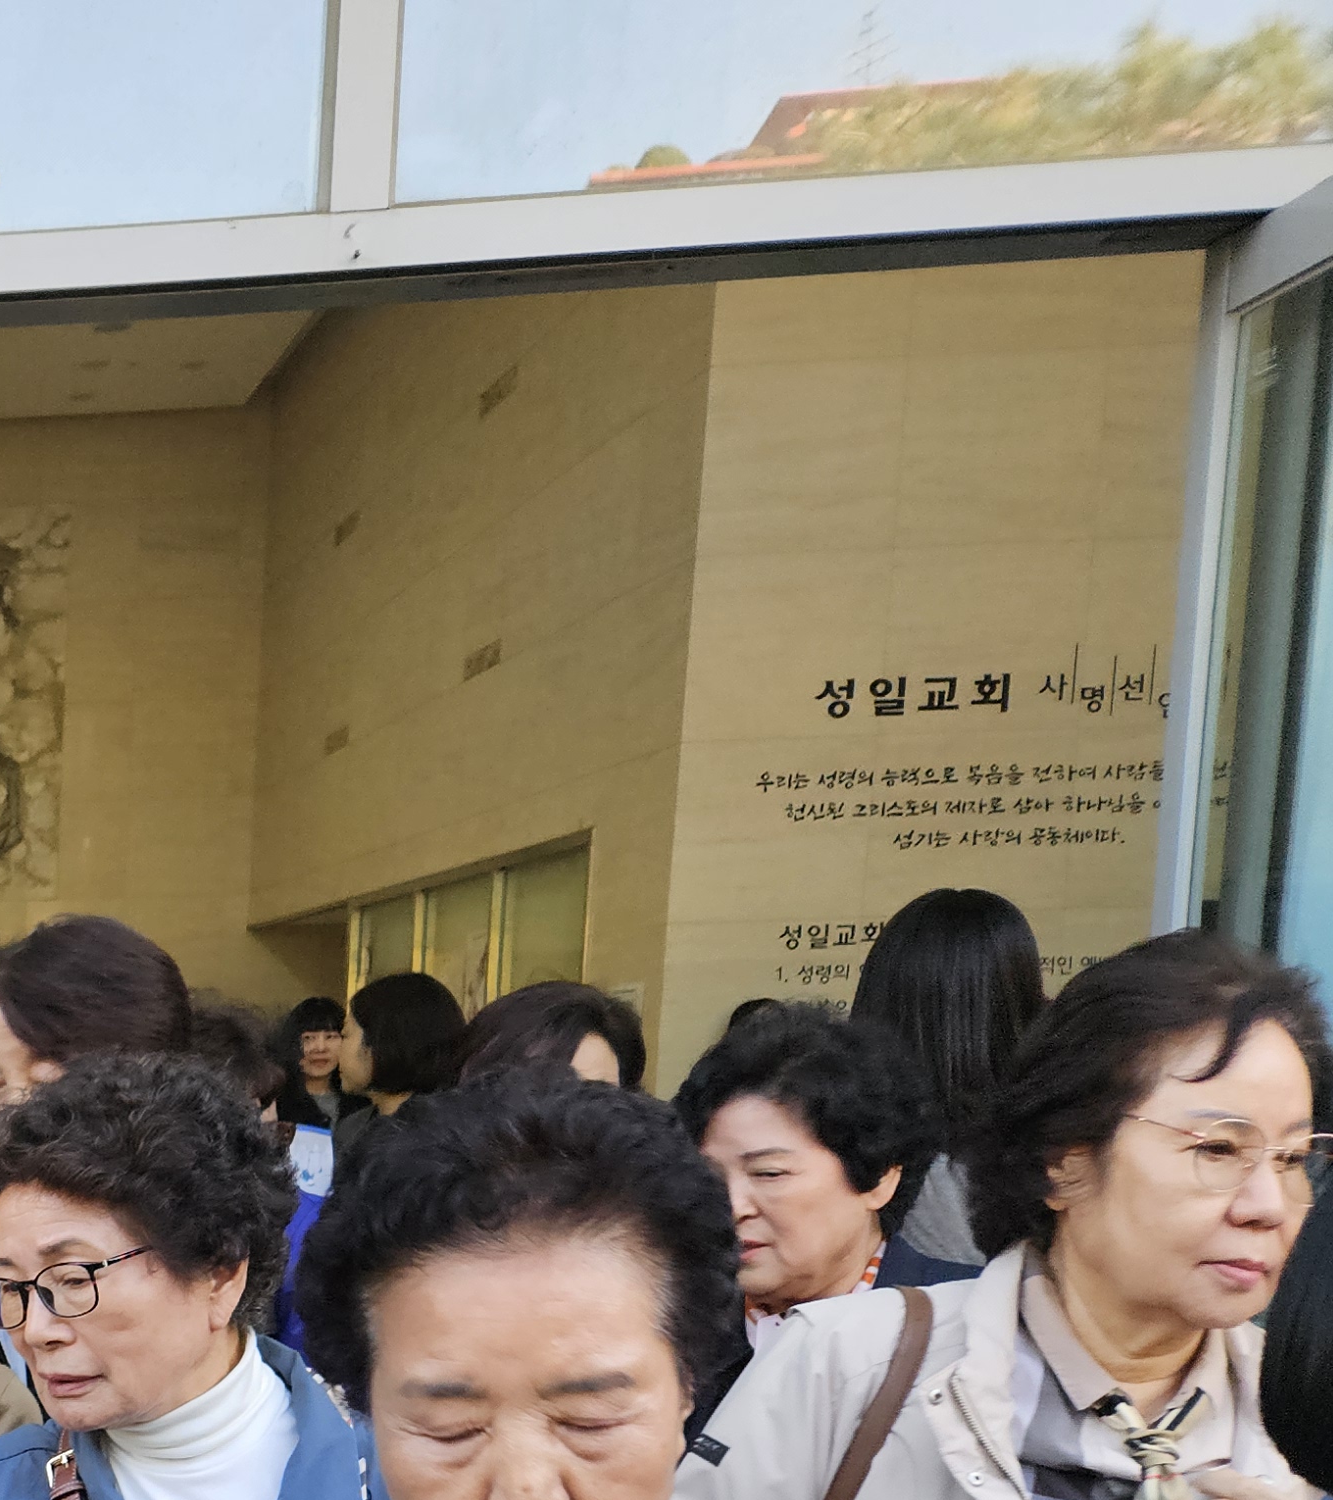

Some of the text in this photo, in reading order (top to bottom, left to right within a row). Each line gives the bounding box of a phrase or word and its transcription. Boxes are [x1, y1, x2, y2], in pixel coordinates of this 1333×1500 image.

[816, 673, 1012, 719] 성일교회
[756, 771, 810, 792] 우리는
[818, 769, 874, 789] 성령의
[881, 767, 959, 786] 능력으로
[966, 763, 1024, 786] 복음을
[1033, 764, 1096, 783] 전하여
[785, 801, 845, 822] 헌신된
[852, 800, 937, 819] 그리스도의
[945, 797, 1005, 815] 제자로
[1013, 796, 1054, 815] 삼아
[1062, 792, 1146, 814] 하나님을
[893, 827, 1125, 850] 섬기는 사랑의 공동체이다.
[775, 967, 789, 983] 1.
[796, 963, 850, 985] 성령의
